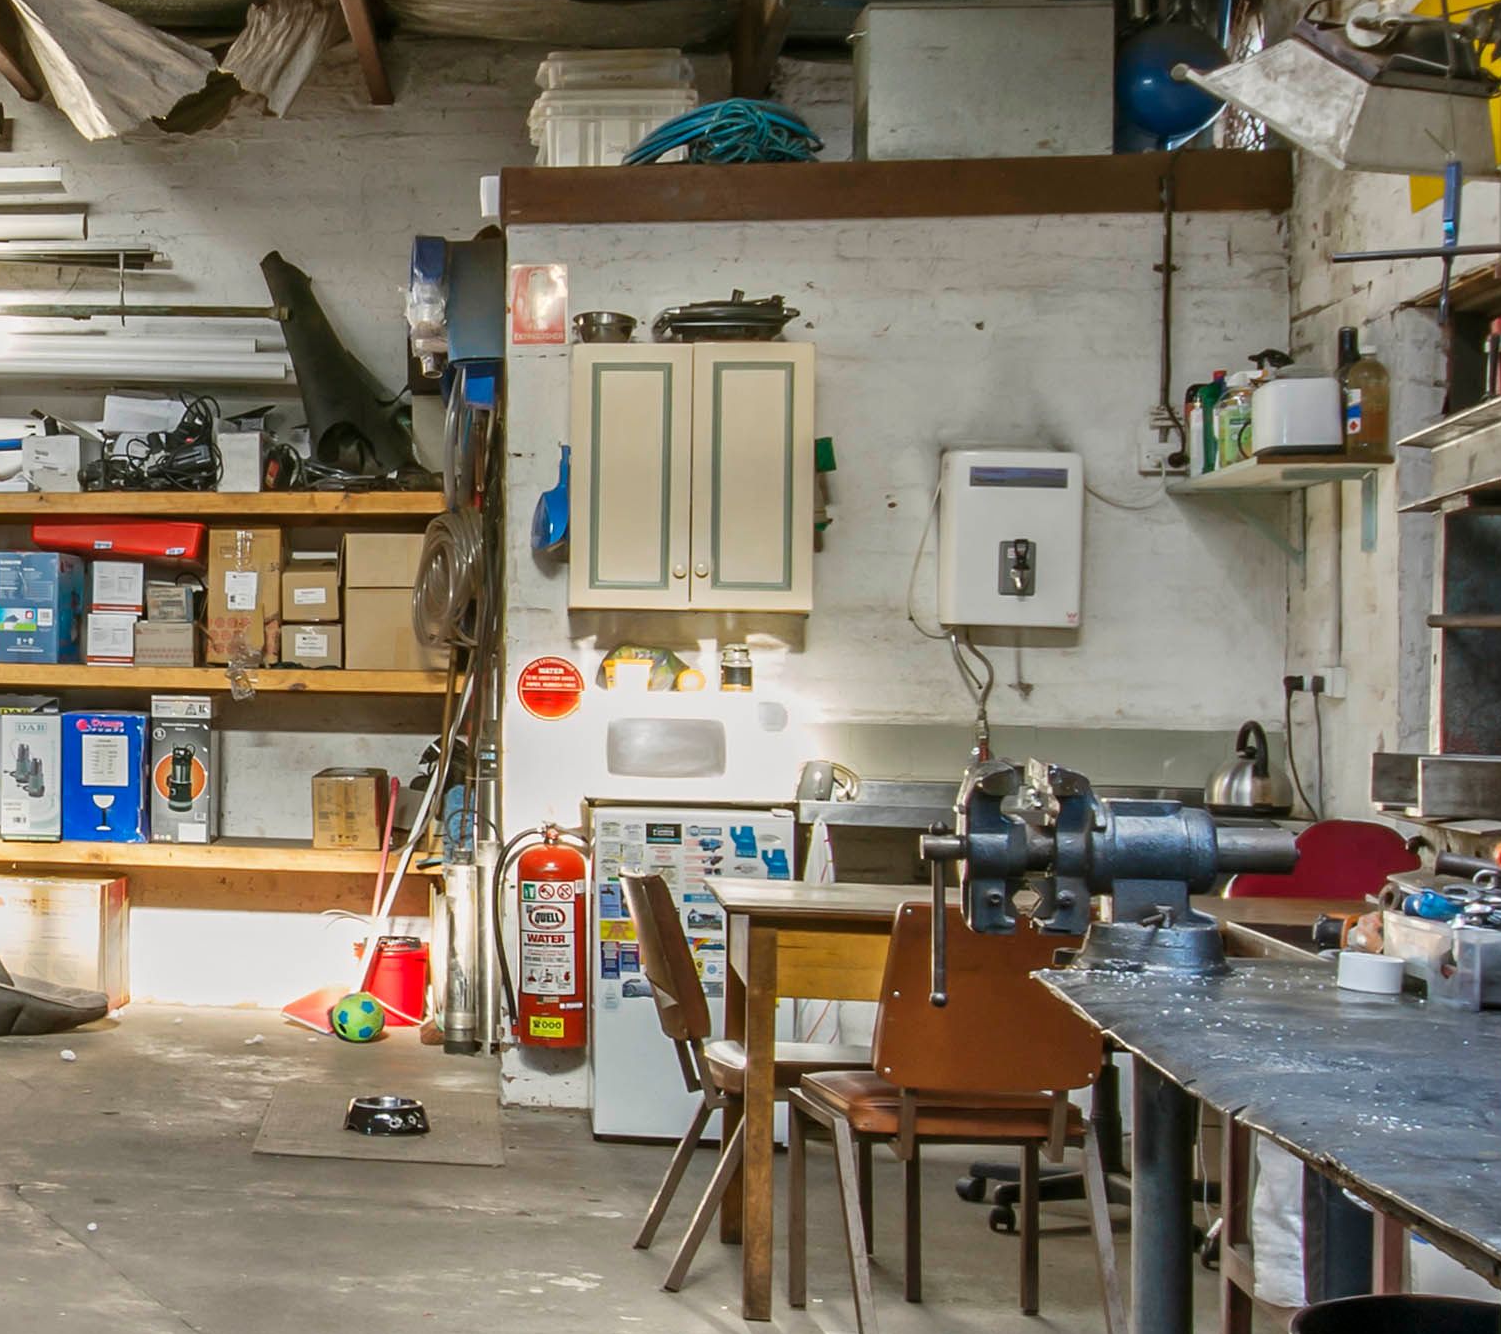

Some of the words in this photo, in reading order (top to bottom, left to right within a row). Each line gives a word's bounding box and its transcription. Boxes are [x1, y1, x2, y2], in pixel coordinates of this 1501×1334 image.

[16, 722, 48, 733] DAB
[534, 912, 560, 924] QUELL
[526, 933, 566, 944] WATER
